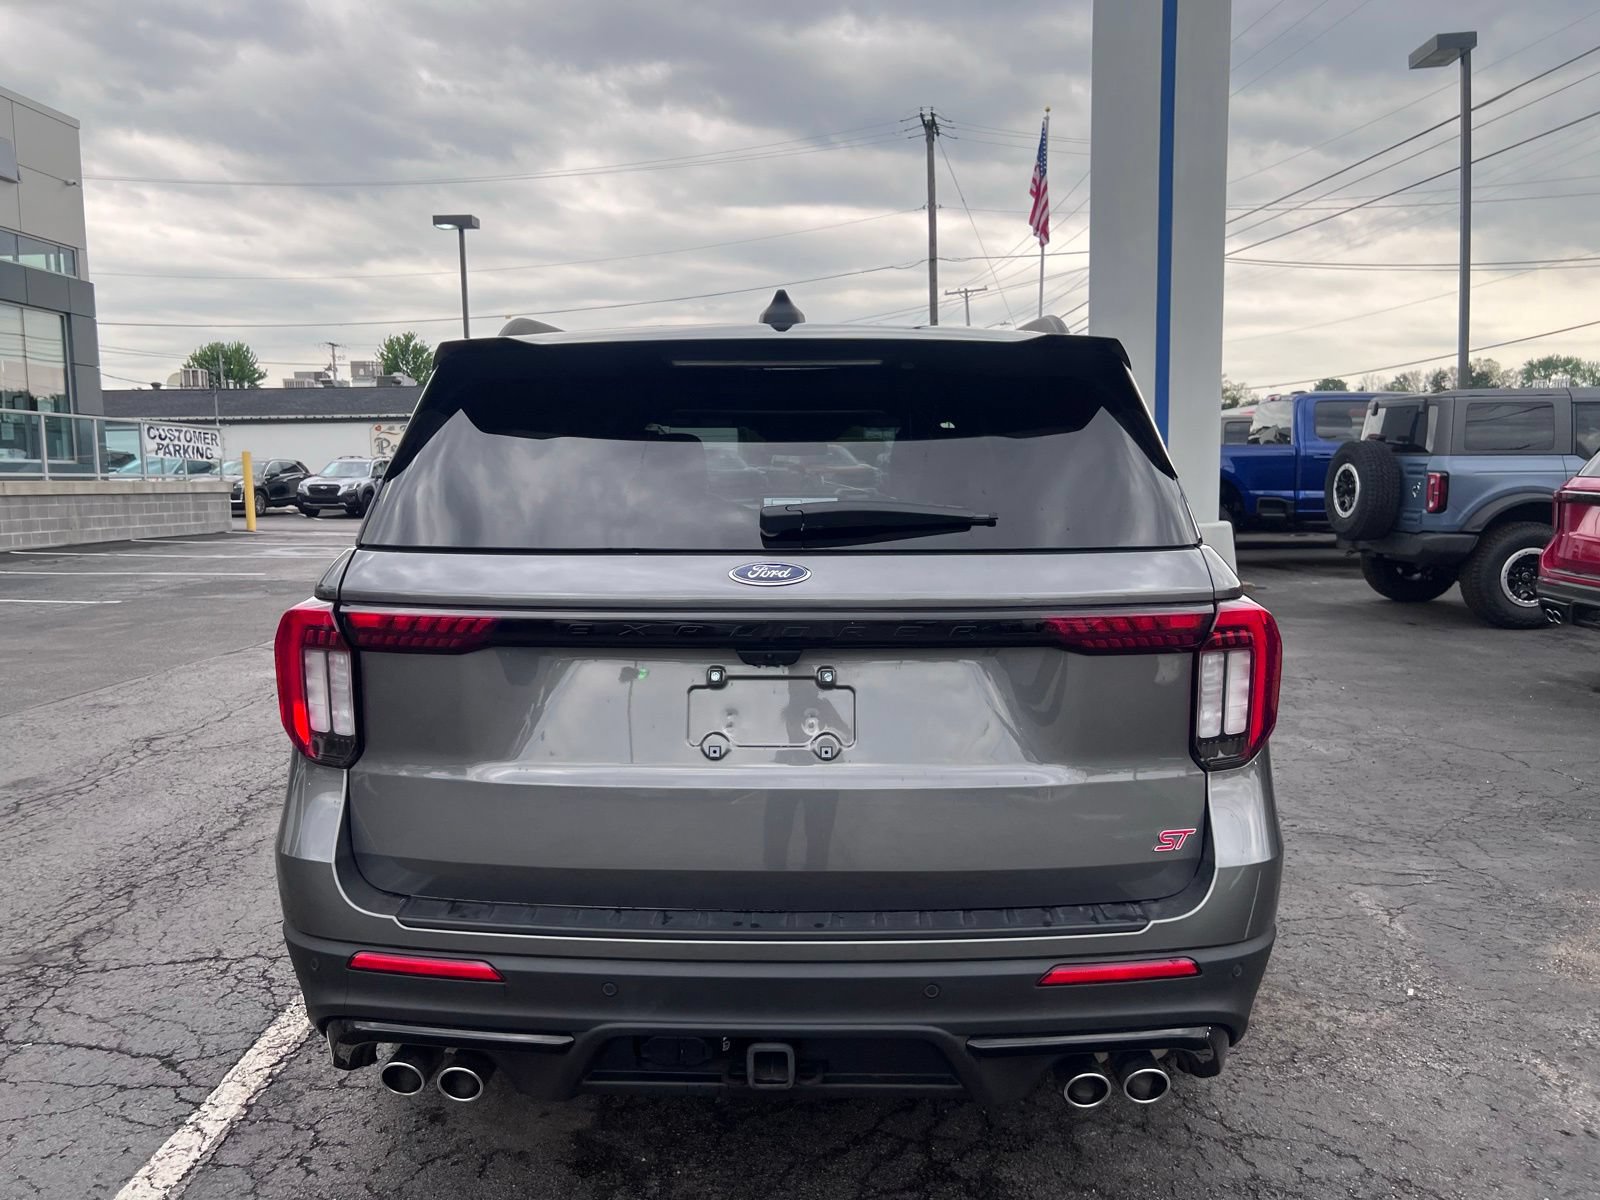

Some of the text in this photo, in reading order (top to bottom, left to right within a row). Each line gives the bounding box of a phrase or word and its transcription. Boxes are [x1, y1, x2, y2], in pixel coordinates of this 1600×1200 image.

[146, 426, 219, 447] CUSTOMER
[155, 442, 214, 460] PARKING
[747, 564, 791, 579] Ford
[567, 623, 979, 638] EXPLORER
[1154, 828, 1196, 851] ST
